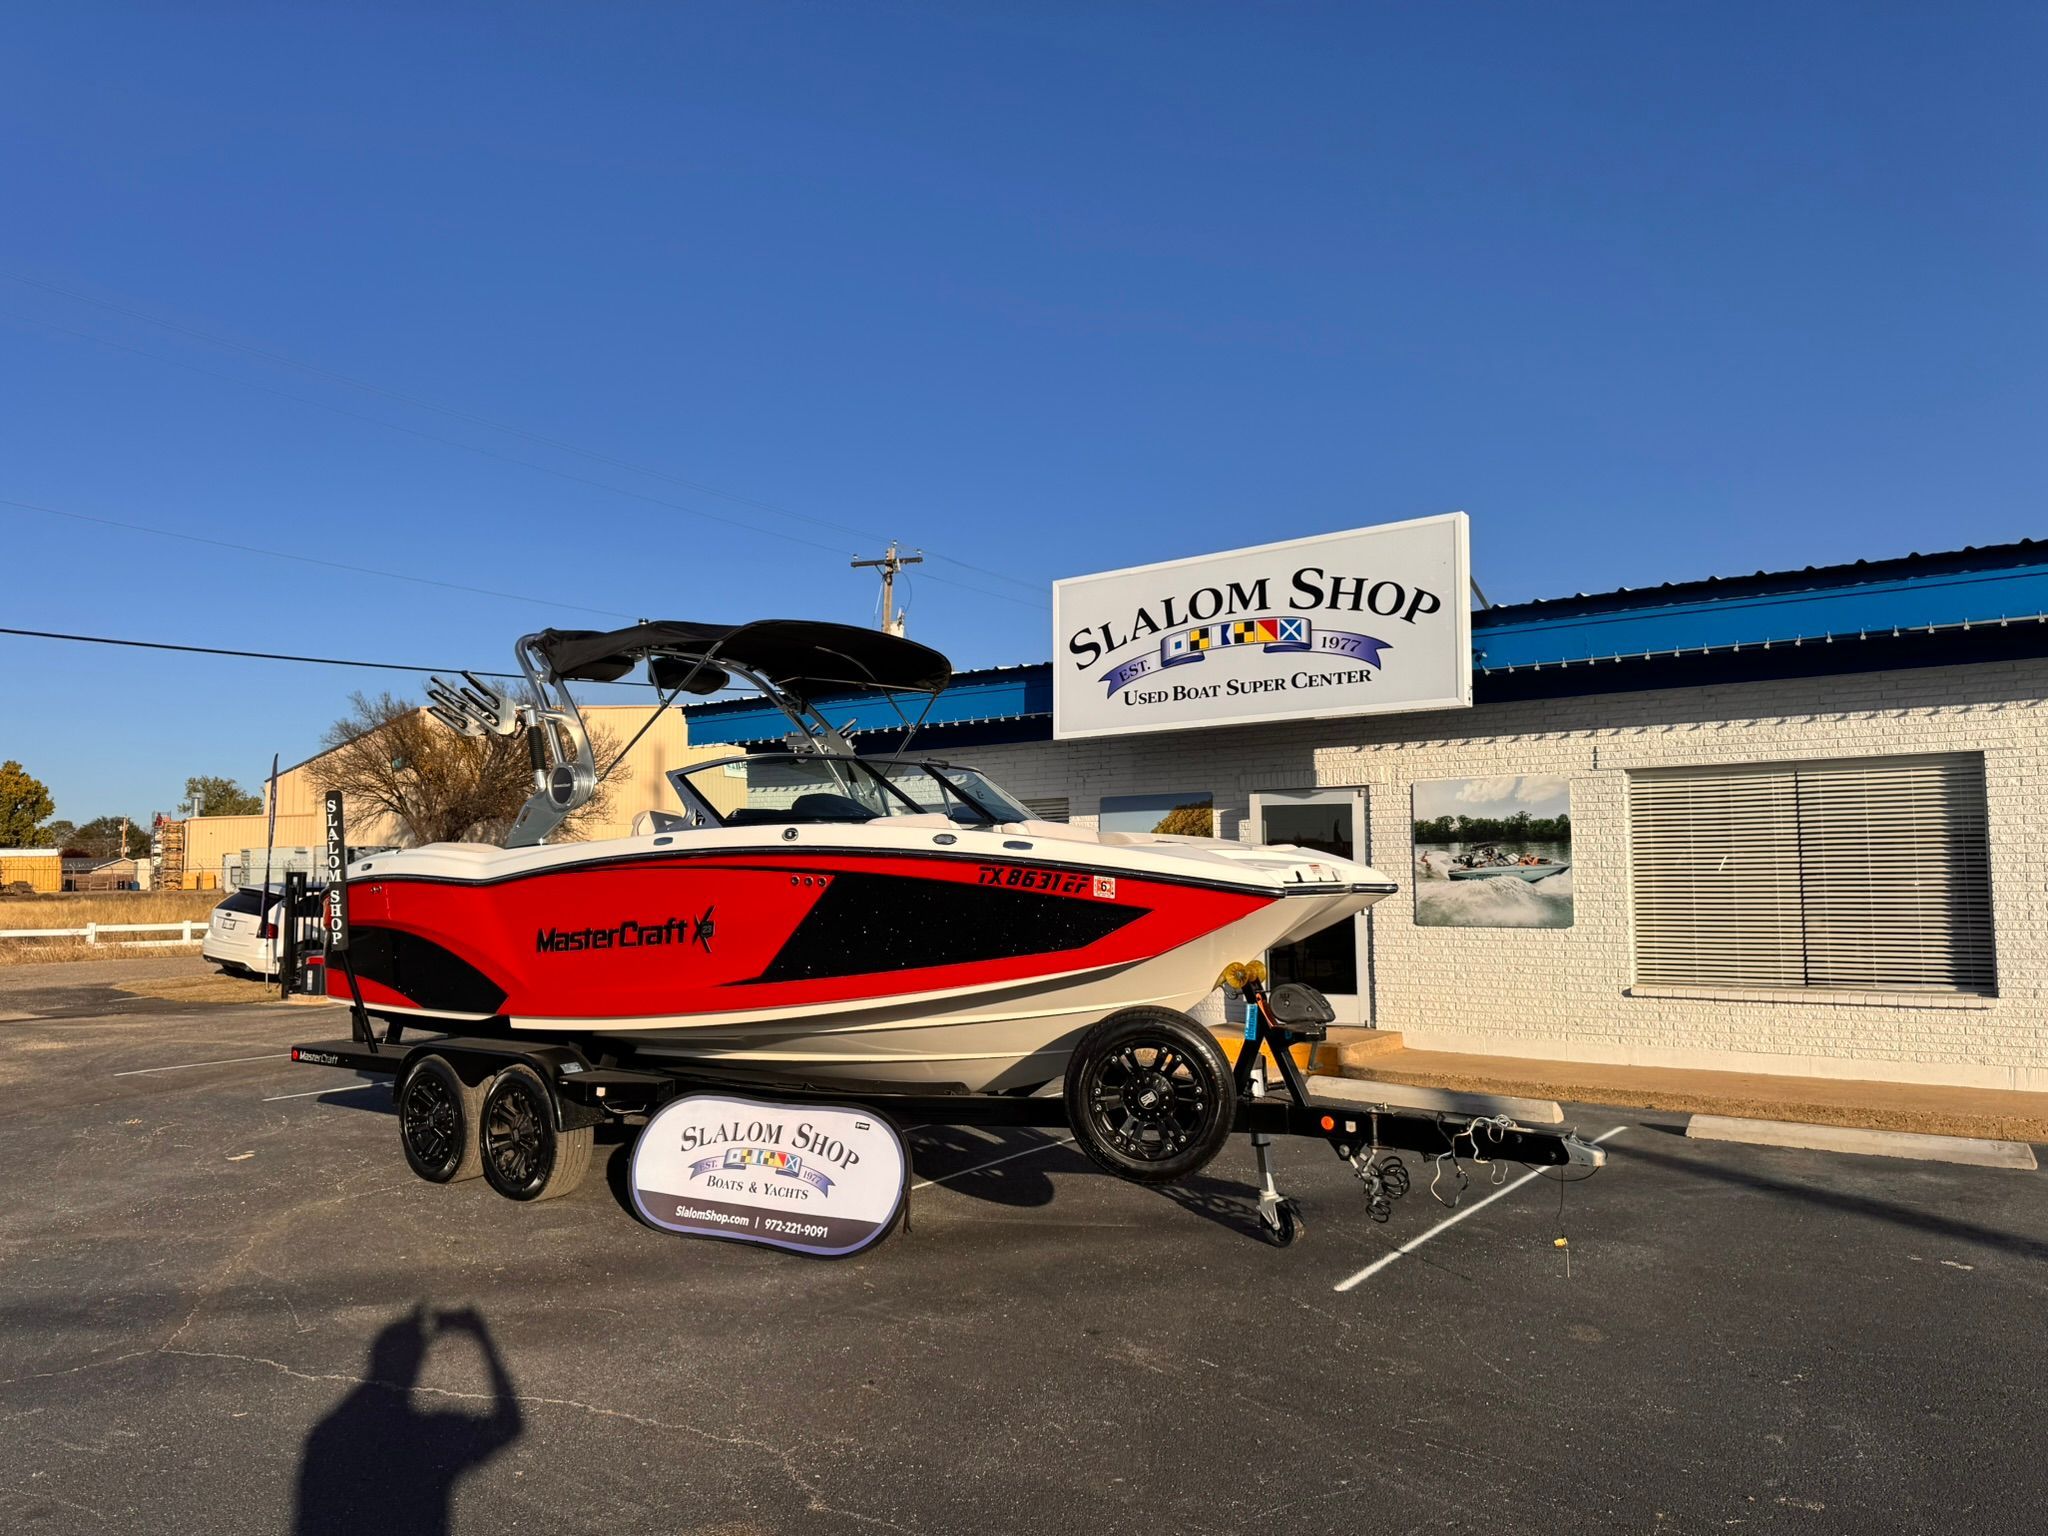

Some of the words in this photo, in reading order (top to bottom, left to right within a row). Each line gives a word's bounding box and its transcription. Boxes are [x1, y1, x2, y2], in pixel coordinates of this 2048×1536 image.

[1069, 578, 1271, 671] SLALOM
[1289, 568, 1441, 625] SHOP
[1118, 660, 1151, 683] EST.
[1322, 635, 1361, 653] 1977
[1123, 690, 1168, 706] USED
[1173, 685, 1221, 701] BOAT
[1226, 679, 1286, 696] SUPER
[1291, 669, 1372, 690] CENTER
[327, 800, 342, 882] SLALOM
[978, 865, 1004, 886] TX
[1005, 869, 1062, 891] 8631
[330, 890, 343, 945] SHOP
[536, 917, 689, 953] MasterCraft
[299, 1050, 339, 1065] MasterCraft
[681, 1121, 783, 1153] SLALOM
[791, 1122, 860, 1171] SHOP
[699, 1159, 718, 1173] EST.
[802, 1170, 823, 1185] 1977
[706, 1175, 744, 1192] BOATS
[748, 1181, 758, 1194] &
[763, 1183, 809, 1200] YACHTS
[675, 1205, 750, 1227] SlalomShop.com
[764, 1218, 829, 1239] 972-221-9091
